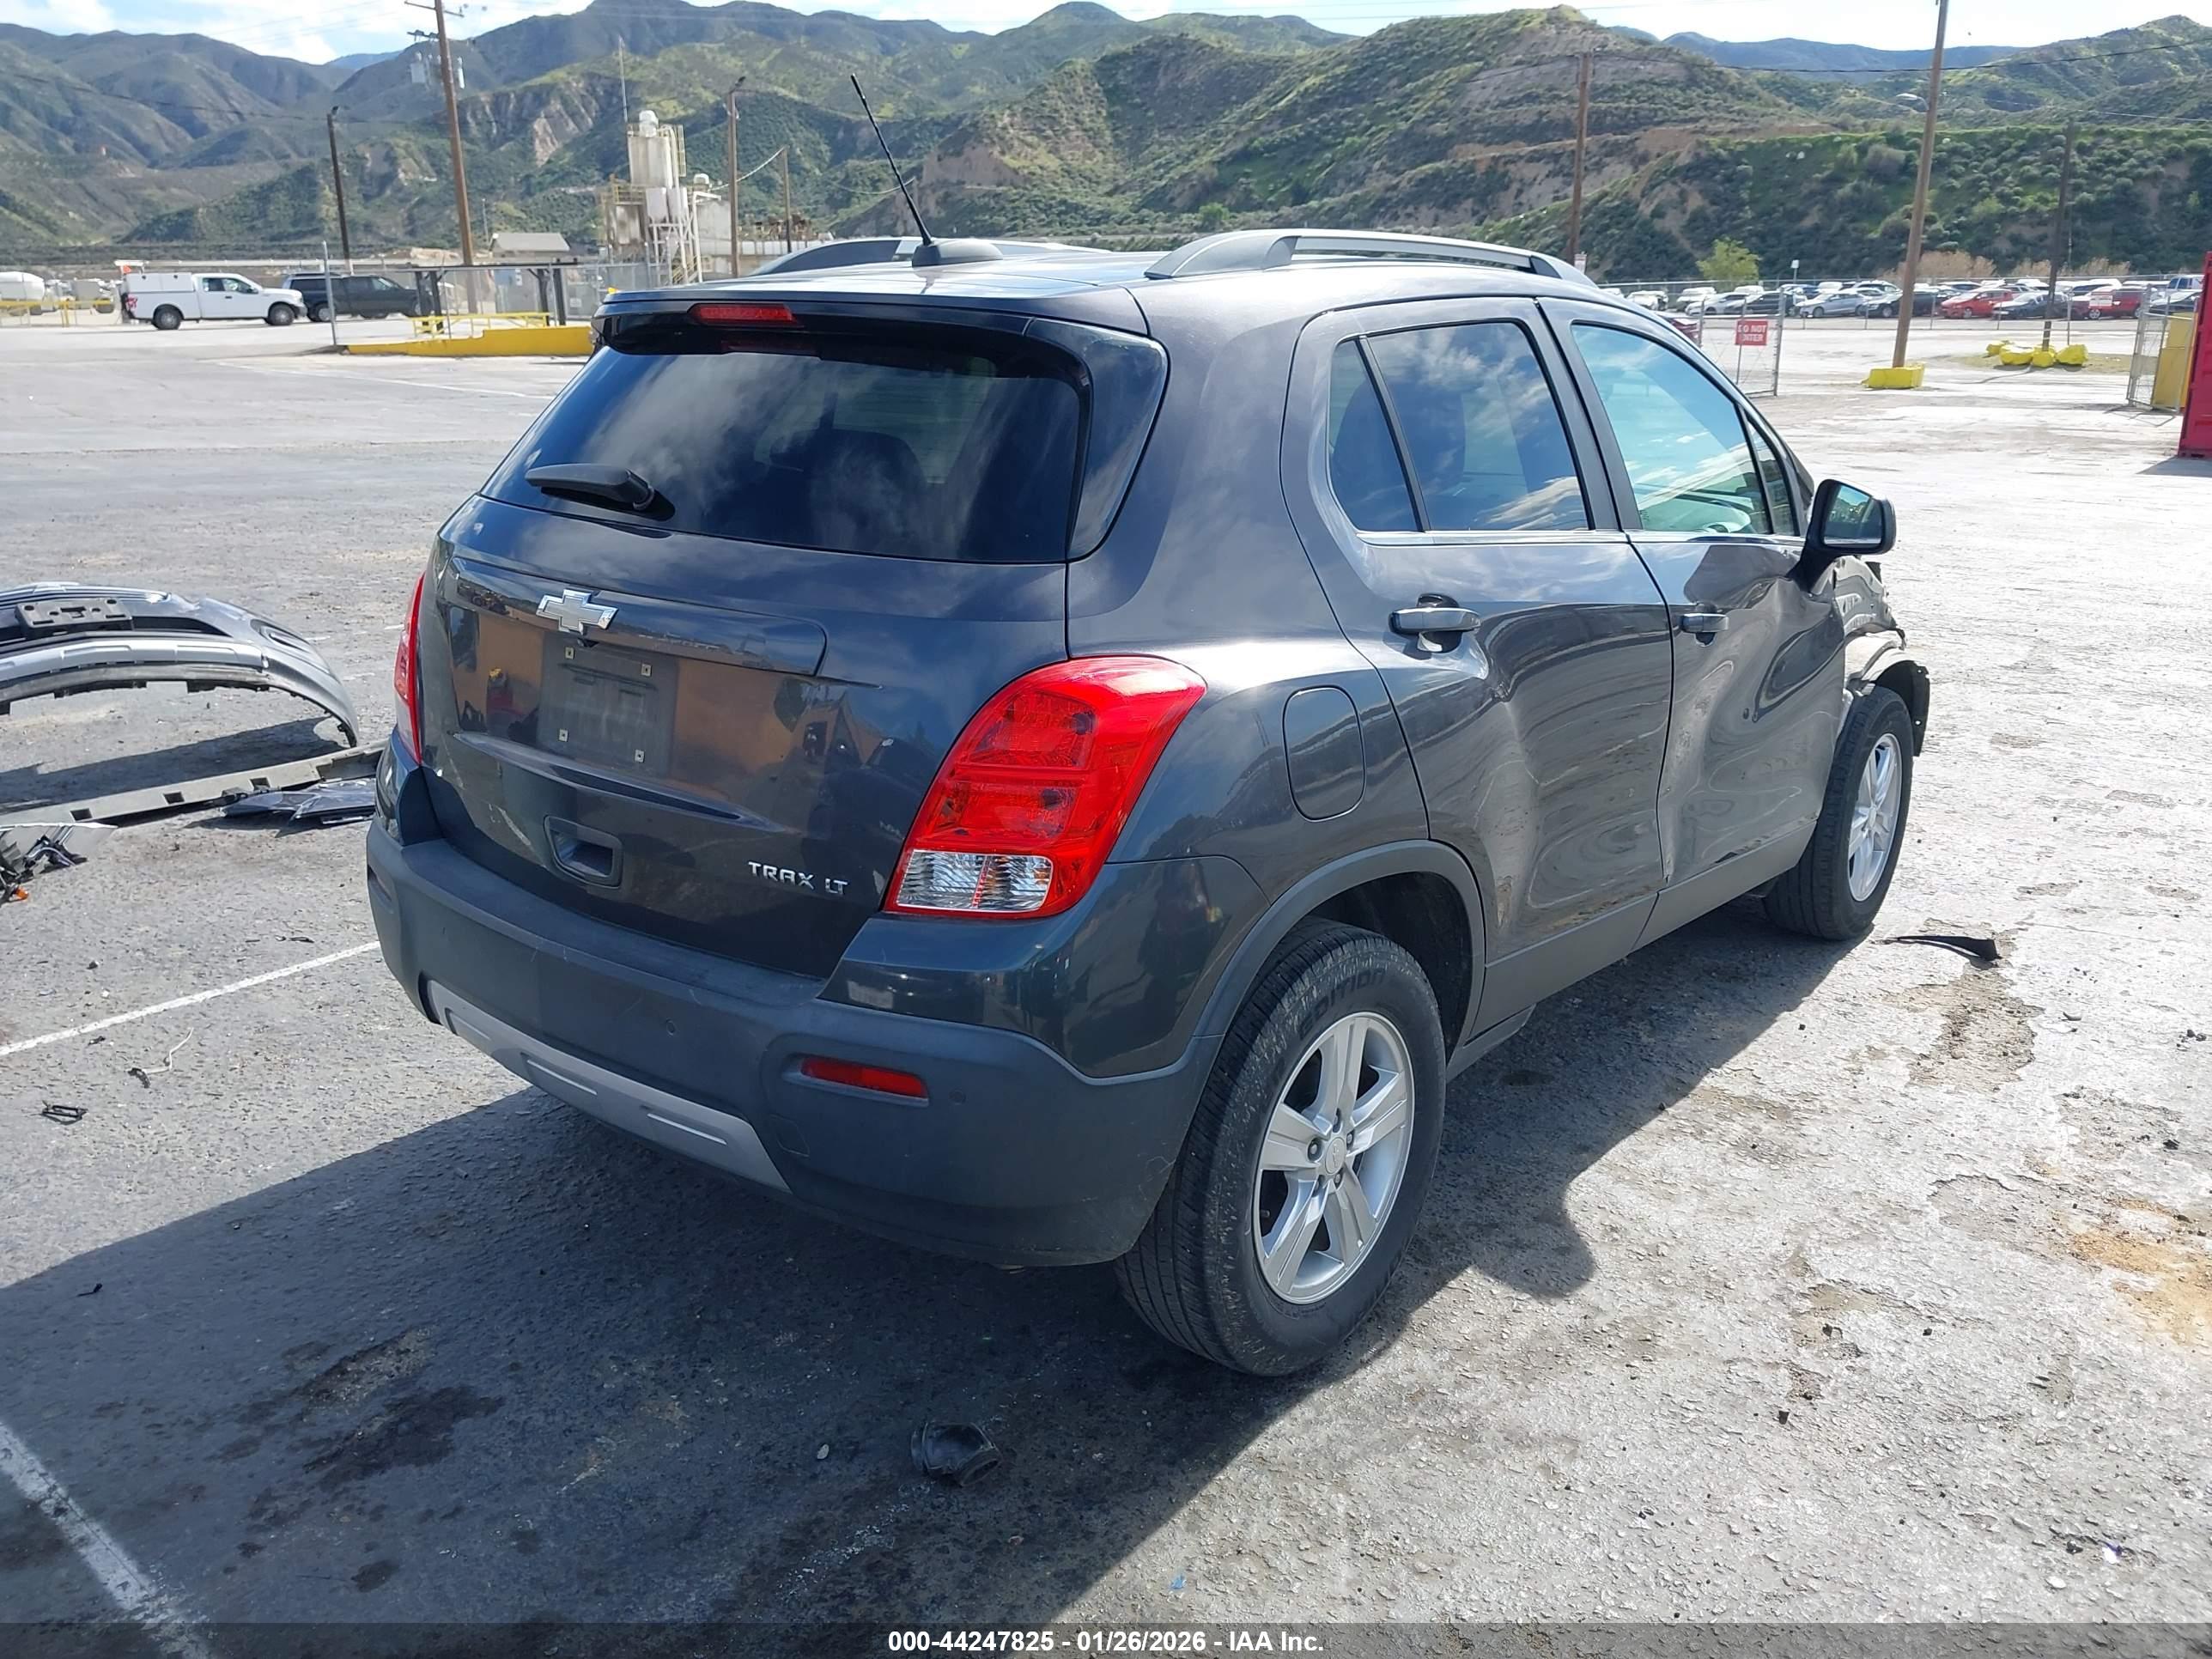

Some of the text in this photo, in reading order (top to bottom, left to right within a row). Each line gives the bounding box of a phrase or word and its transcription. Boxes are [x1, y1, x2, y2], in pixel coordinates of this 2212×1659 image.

[1751, 325, 1766, 333] NOT
[748, 861, 848, 895] TRAX LT
